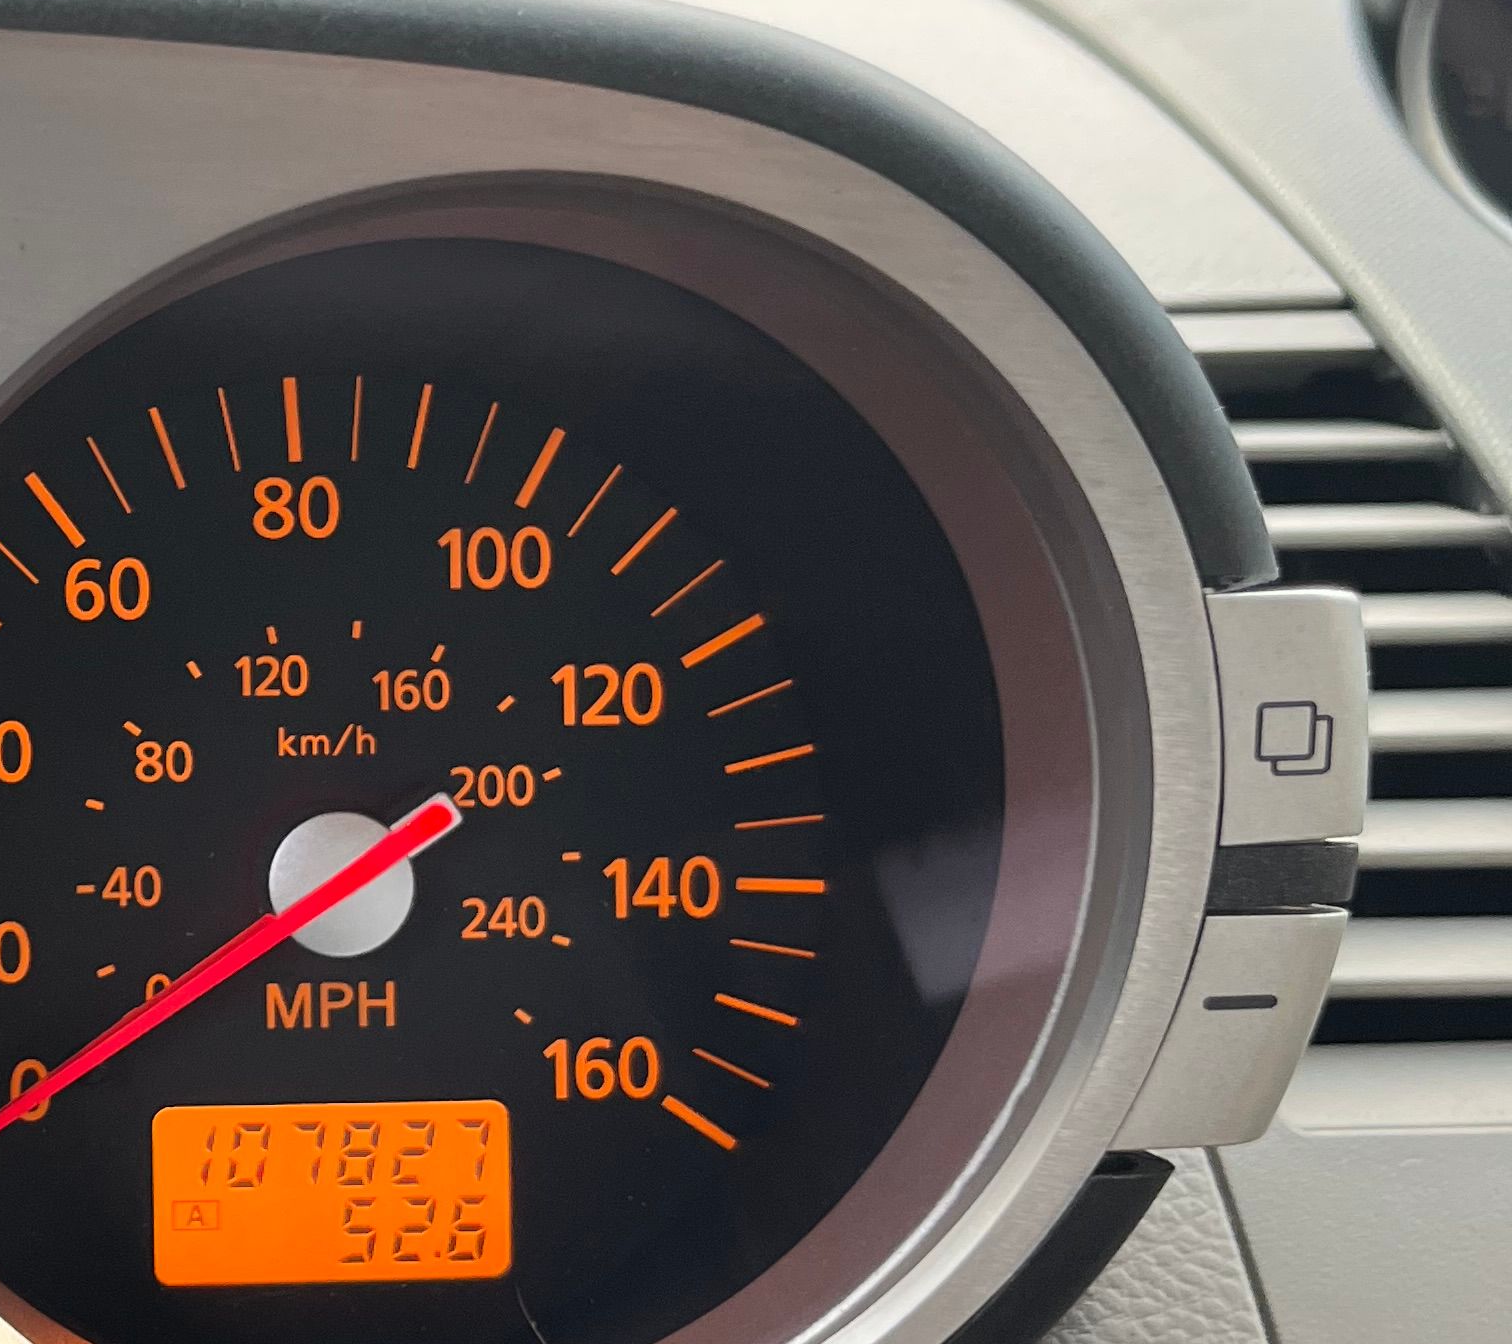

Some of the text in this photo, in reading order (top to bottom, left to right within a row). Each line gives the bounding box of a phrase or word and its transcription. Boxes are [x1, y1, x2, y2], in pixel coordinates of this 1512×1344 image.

[253, 476, 340, 540] 80
[438, 526, 552, 591] 100
[64, 557, 151, 622] 60
[234, 654, 310, 698] 120
[372, 668, 451, 712] 160
[551, 662, 664, 727] 120
[134, 740, 194, 784] 80
[277, 723, 377, 757] km/h
[449, 764, 536, 808] 200
[101, 865, 162, 909] 40
[603, 855, 722, 920] 140
[461, 895, 547, 941] 240
[265, 981, 397, 1030] MPH
[10, 1059, 51, 1122] 0
[543, 1036, 661, 1101] 160
[200, 1118, 490, 1188] 107827
